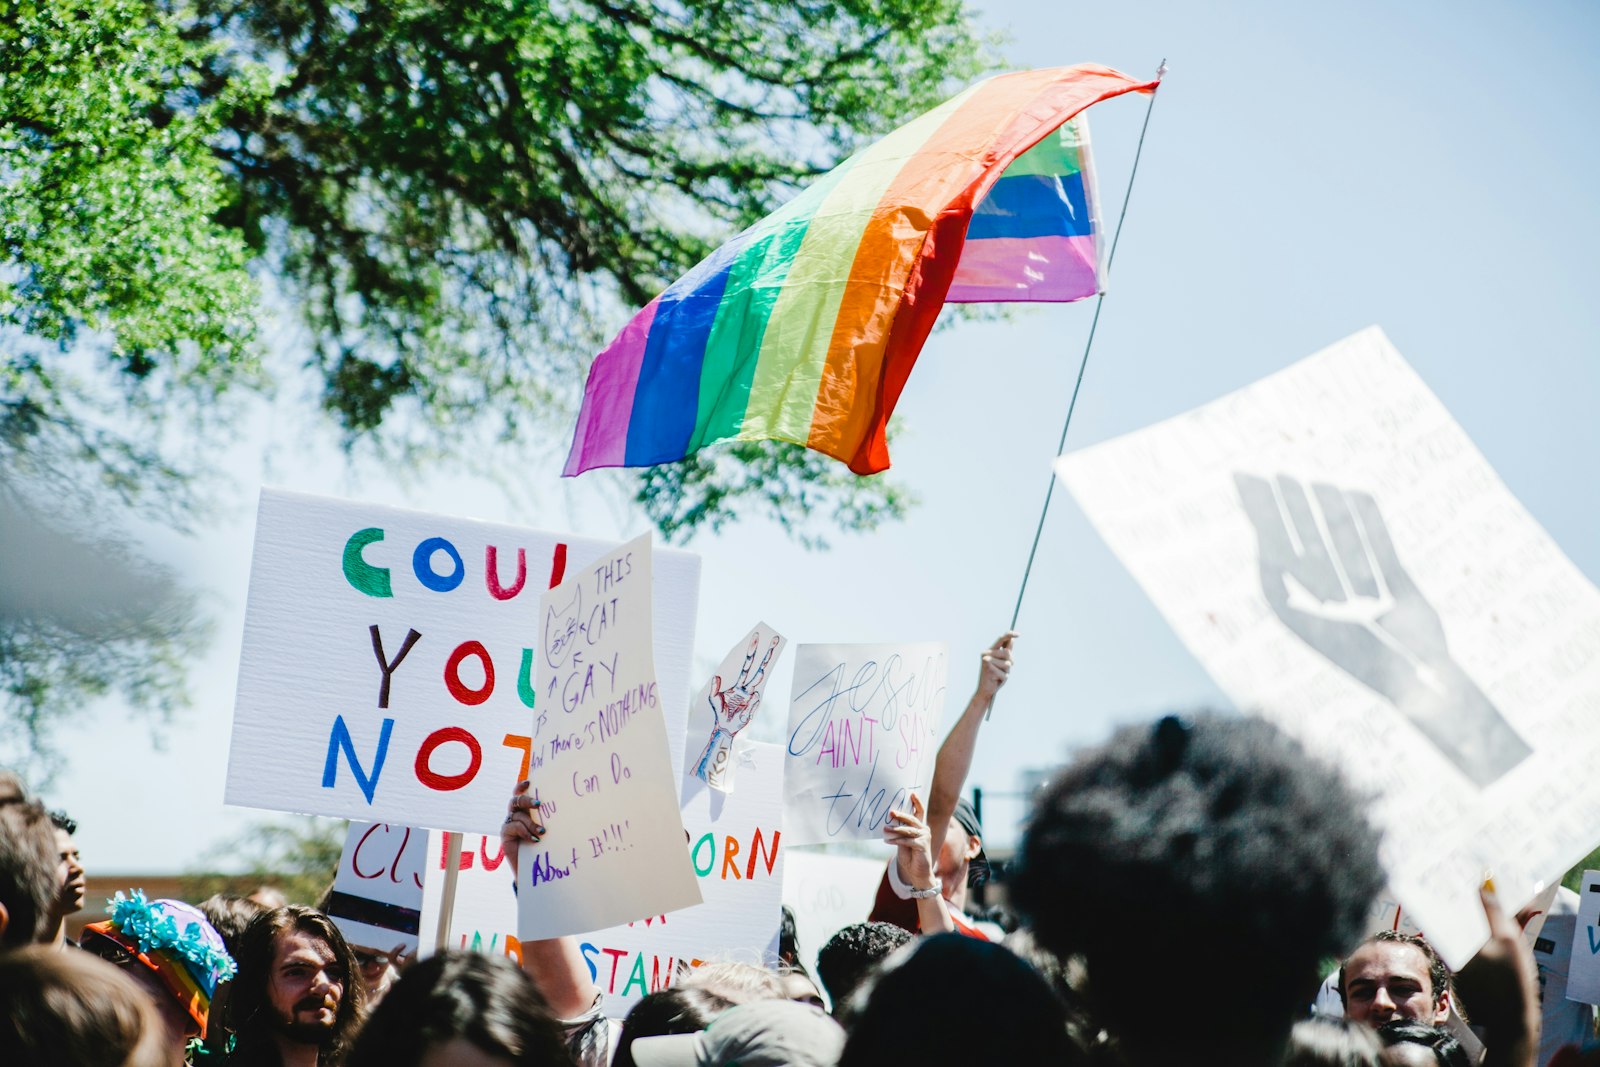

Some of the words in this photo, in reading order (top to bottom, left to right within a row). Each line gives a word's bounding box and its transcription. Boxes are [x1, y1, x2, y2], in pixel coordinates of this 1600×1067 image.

[342, 527, 567, 600] COU
[594, 552, 632, 594] THIS
[586, 598, 618, 645] CAT
[562, 652, 618, 713] GAY
[599, 682, 657, 743] NOTHING
[817, 711, 878, 769] AIN'T
[573, 771, 600, 797] Can
[610, 752, 631, 785] Do
[532, 848, 581, 887] About
[692, 826, 781, 881] ORN
